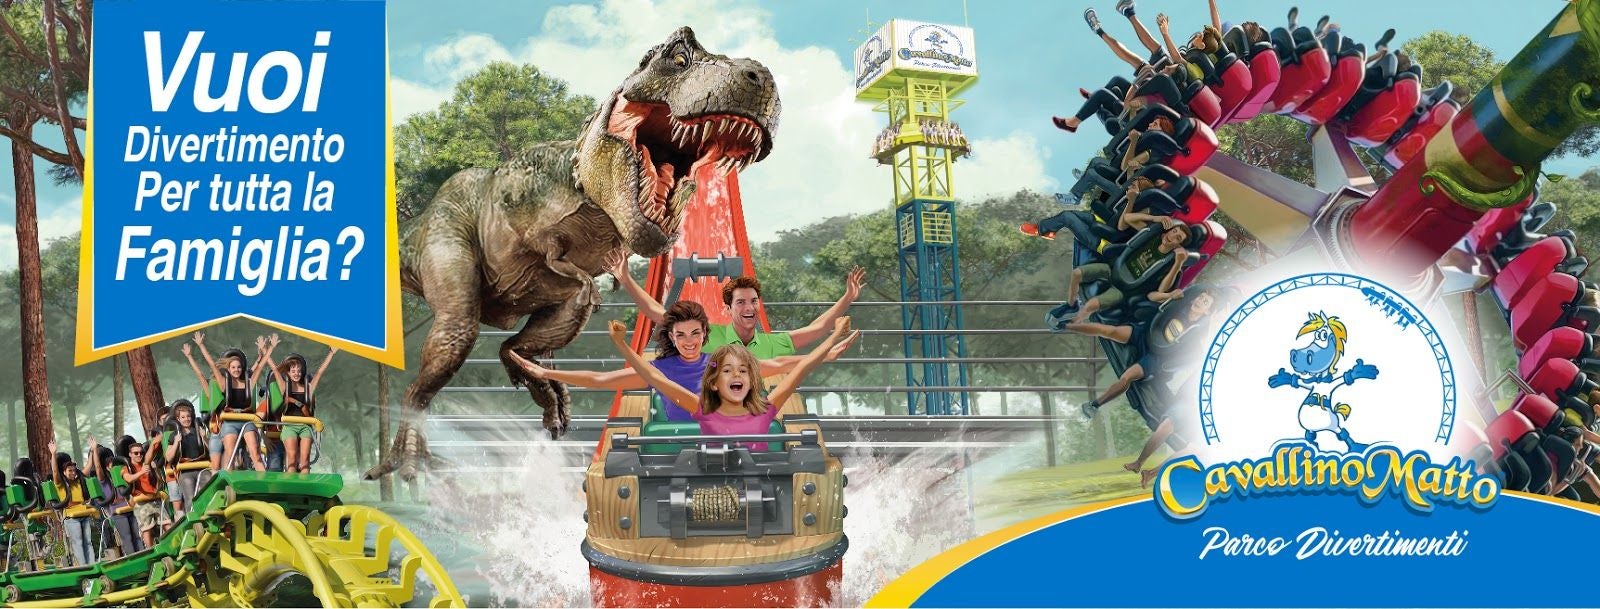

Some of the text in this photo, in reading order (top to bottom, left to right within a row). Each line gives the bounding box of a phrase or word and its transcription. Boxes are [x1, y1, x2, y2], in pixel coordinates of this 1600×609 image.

[144, 31, 331, 113] Vuoi
[124, 126, 345, 162] Divertimento
[135, 171, 334, 211] Per tutta la
[116, 226, 364, 296] Famiglia?
[1200, 527, 1468, 560] Parco Divertimenti
